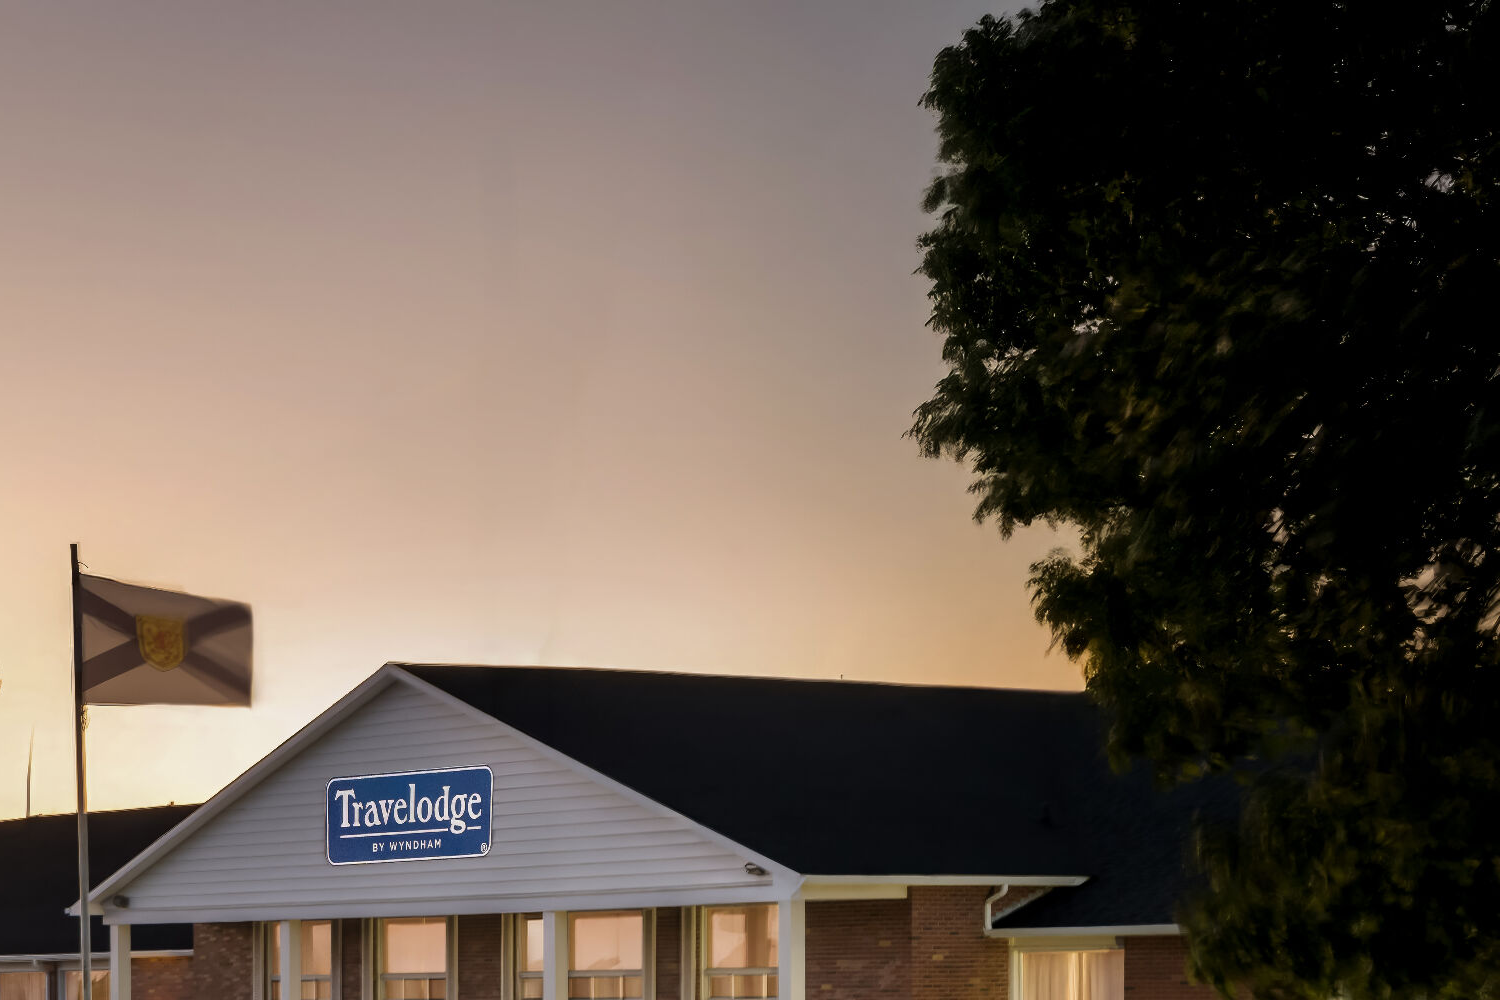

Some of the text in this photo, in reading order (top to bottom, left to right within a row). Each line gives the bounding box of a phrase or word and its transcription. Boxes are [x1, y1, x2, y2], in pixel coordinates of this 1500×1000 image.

[335, 784, 482, 834] Travelodge
[372, 839, 442, 853] BY WYNDHAM
